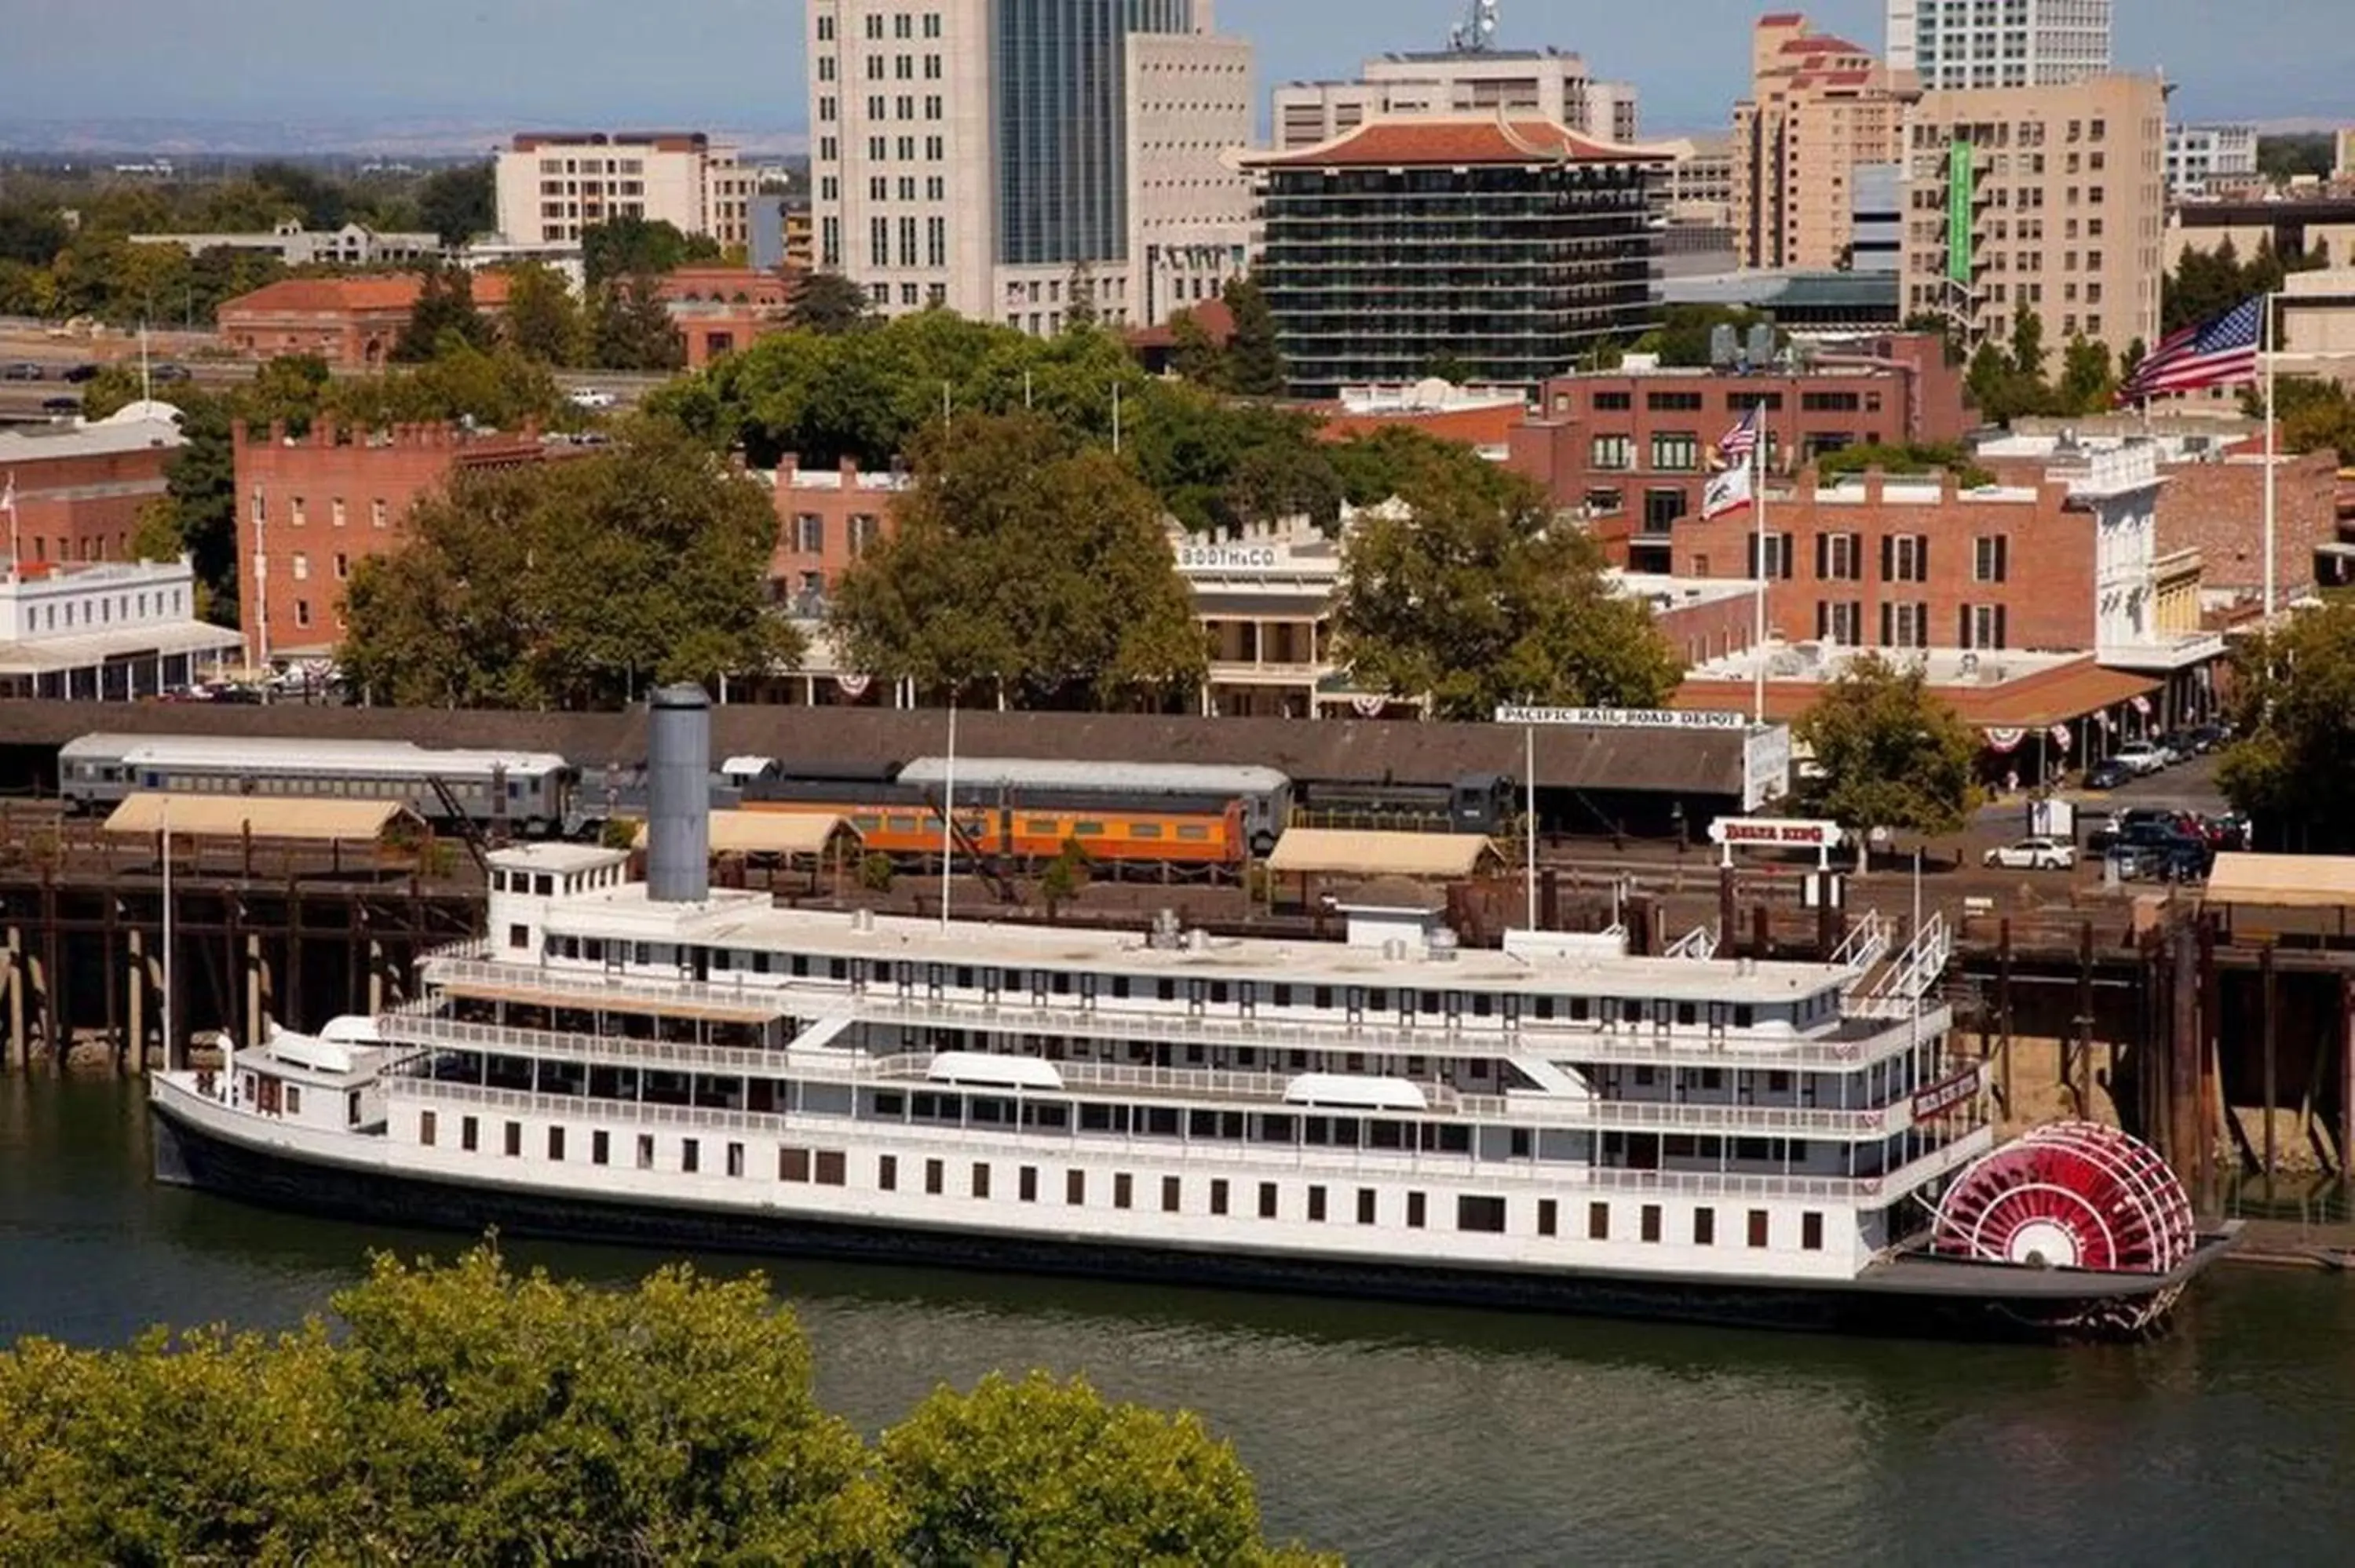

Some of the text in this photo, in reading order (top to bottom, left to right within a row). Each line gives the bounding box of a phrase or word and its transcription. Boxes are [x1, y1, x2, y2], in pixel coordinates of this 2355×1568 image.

[1503, 708, 1737, 726] PACIFIC RAIL ROAD DEPOT
